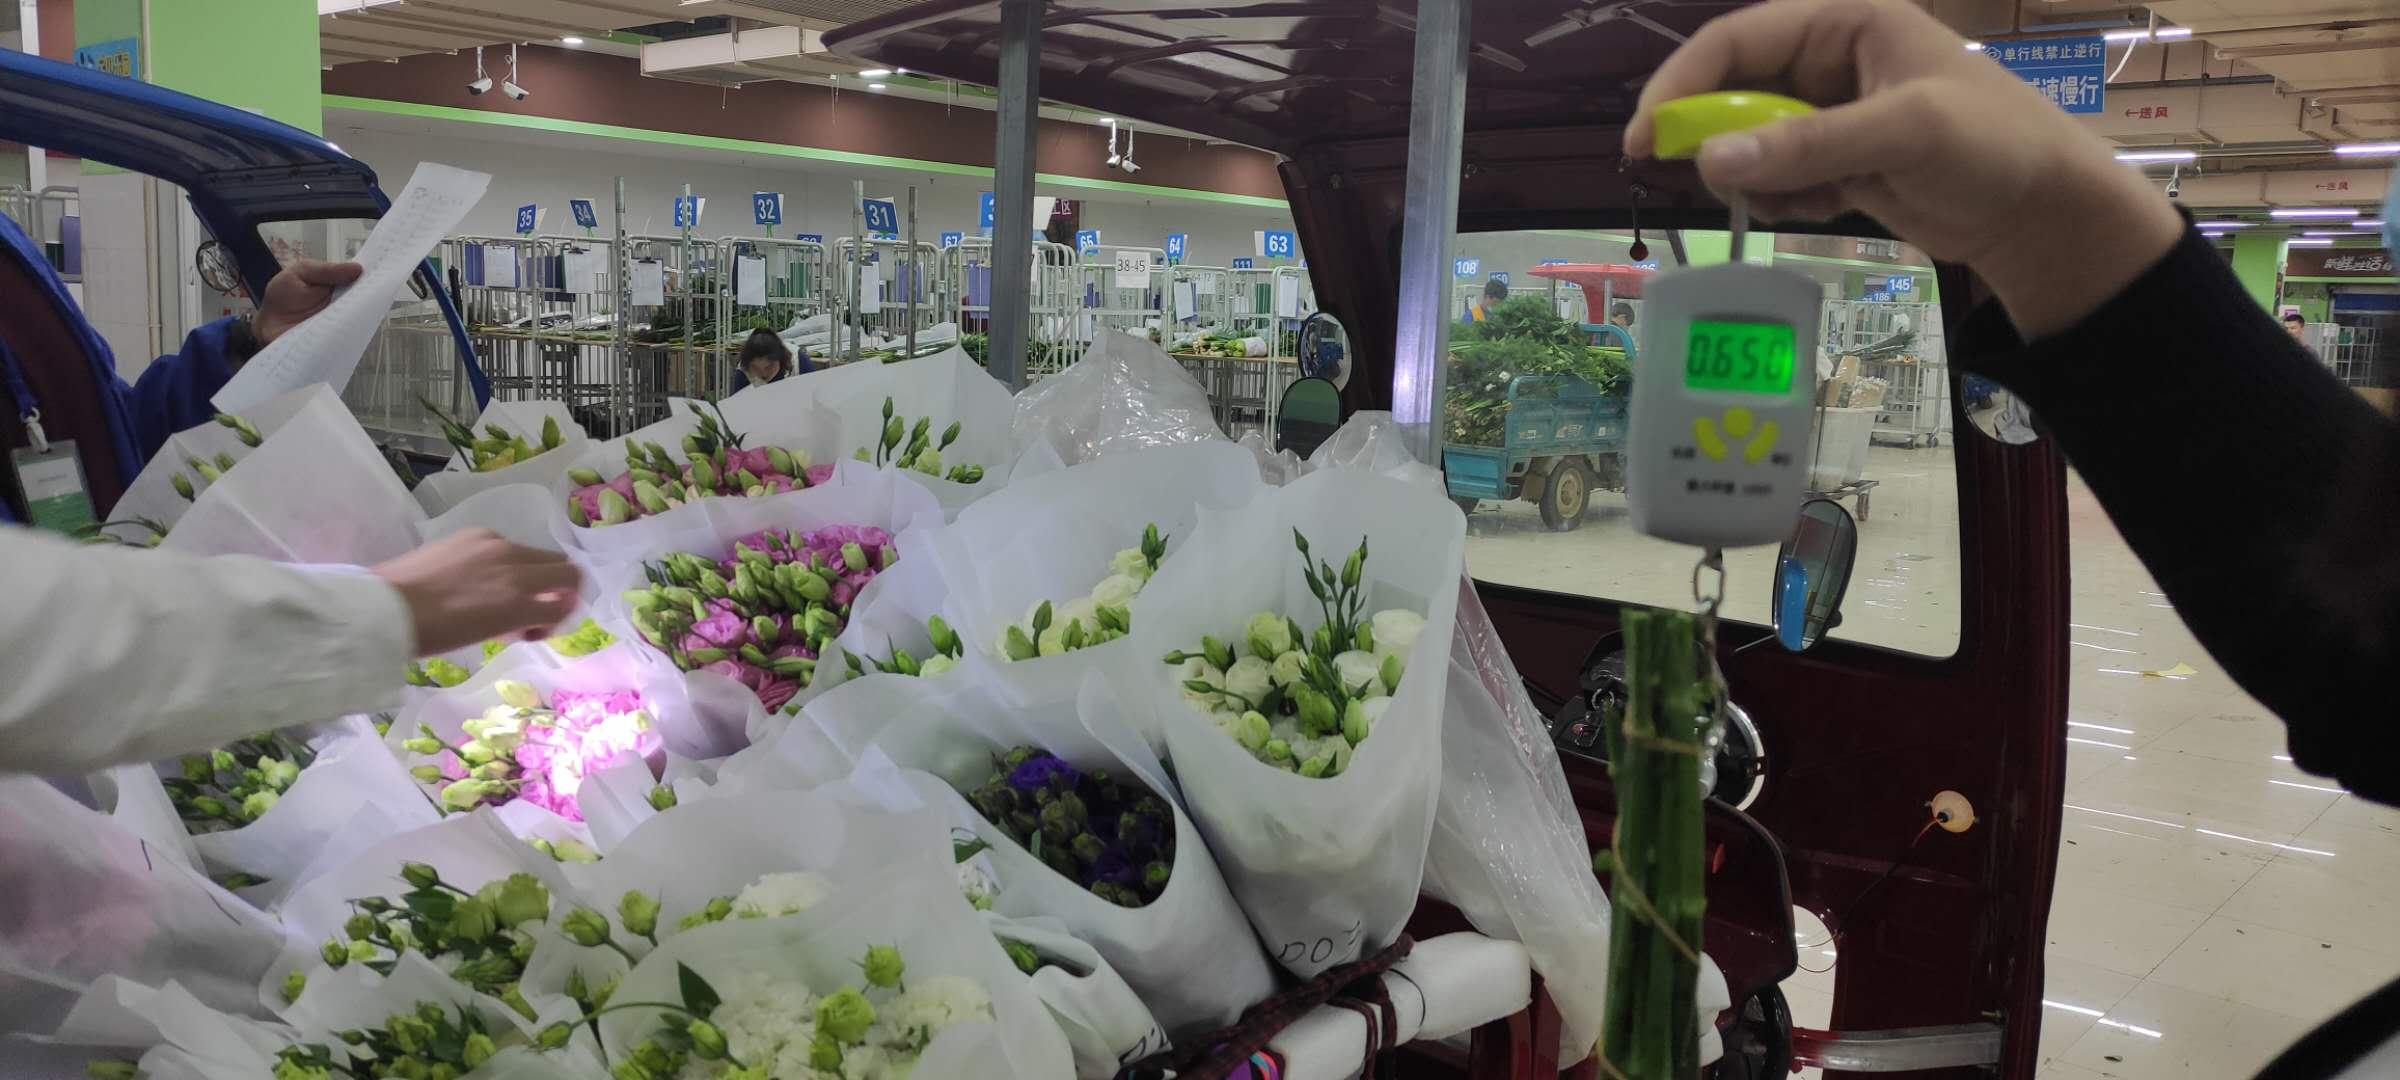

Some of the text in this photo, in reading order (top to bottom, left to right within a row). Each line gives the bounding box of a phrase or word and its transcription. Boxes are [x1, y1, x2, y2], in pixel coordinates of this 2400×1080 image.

[2004, 43, 2102, 61] 单行线禁止逆行
[2138, 106, 2169, 119] 送风
[519, 209, 532, 228] 35
[574, 204, 592, 222] 34
[757, 199, 776, 220] 32
[868, 204, 890, 228] 31
[1169, 237, 1181, 254] 64
[1268, 235, 1288, 253] 63
[1117, 258, 1146, 273] 38-45
[1455, 261, 1477, 275] 108
[1889, 278, 1911, 291] 145
